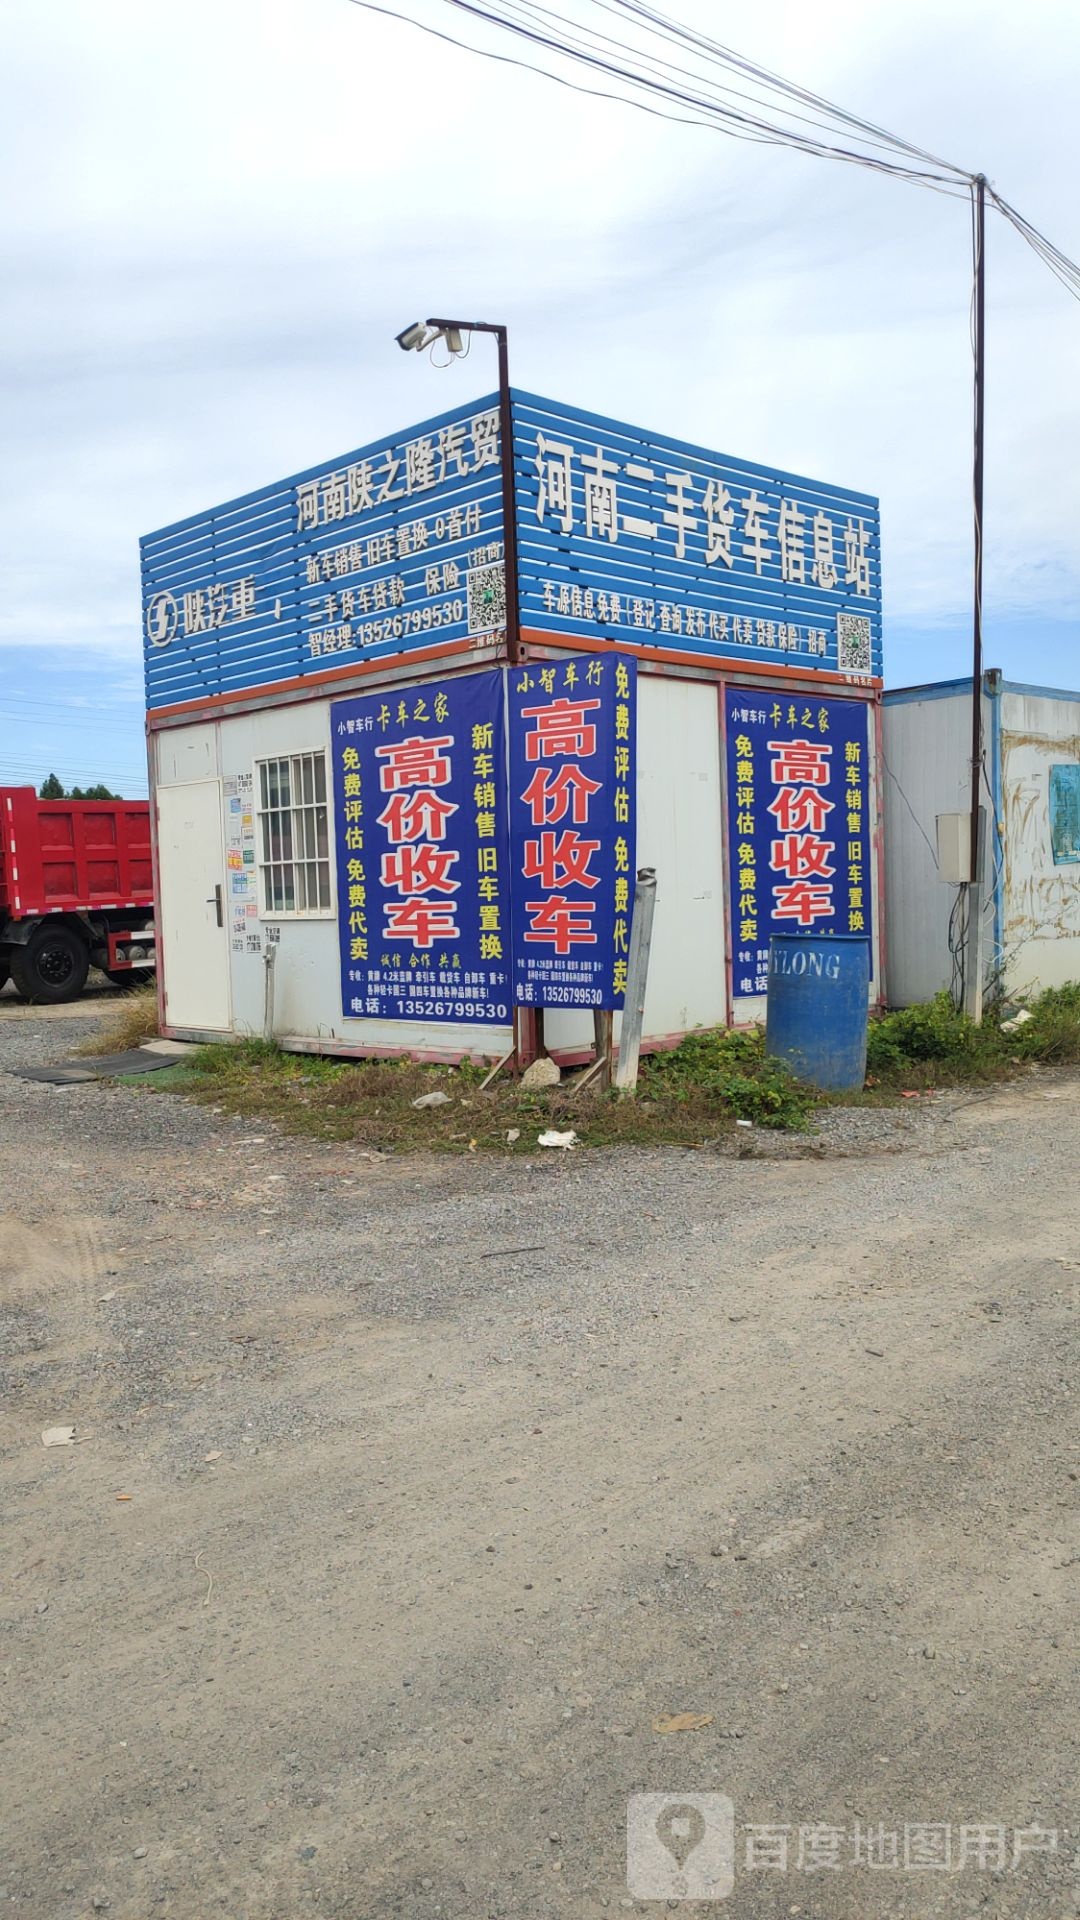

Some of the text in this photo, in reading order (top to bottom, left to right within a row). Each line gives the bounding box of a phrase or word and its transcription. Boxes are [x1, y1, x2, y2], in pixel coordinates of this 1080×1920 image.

[296, 409, 500, 532] 河南陕之隆汽贸
[535, 431, 870, 596] 河南二手货车信息站
[306, 504, 482, 583] 新车销售 旧车置换 0首付
[308, 562, 460, 622] 二手货车贷款 保险
[337, 692, 449, 735] 小智车行 卡车之家
[517, 660, 604, 694] 小智车行
[731, 702, 830, 733] 小智车行 卡车之家
[375, 735, 461, 948] 高价收车
[520, 698, 603, 954] 高价收车
[767, 739, 836, 925] 高价收车
